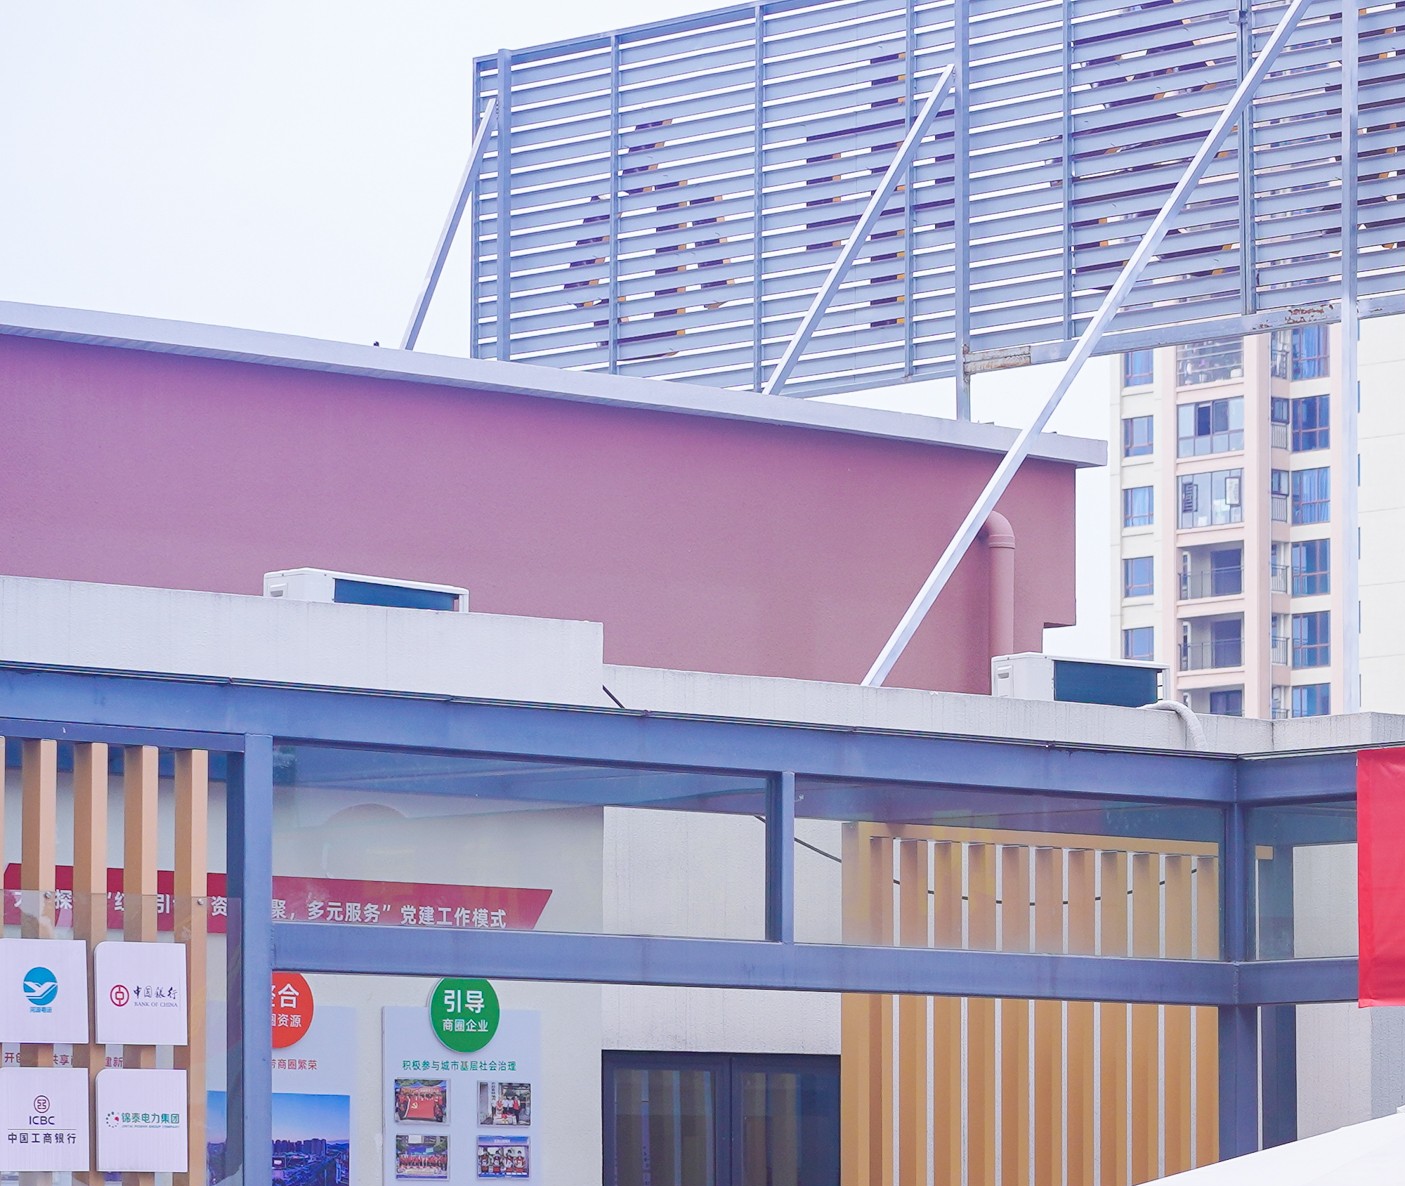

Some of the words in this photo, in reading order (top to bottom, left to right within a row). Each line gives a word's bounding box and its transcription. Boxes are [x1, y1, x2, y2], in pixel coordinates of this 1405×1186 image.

[444, 989, 485, 1014] 引导
[442, 1018, 489, 1033] 商圈企业
[29, 1115, 55, 1125] ICBC
[121, 1112, 180, 1124] 锦泰电力集团
[8, 1132, 77, 1145] 中国工商银行
